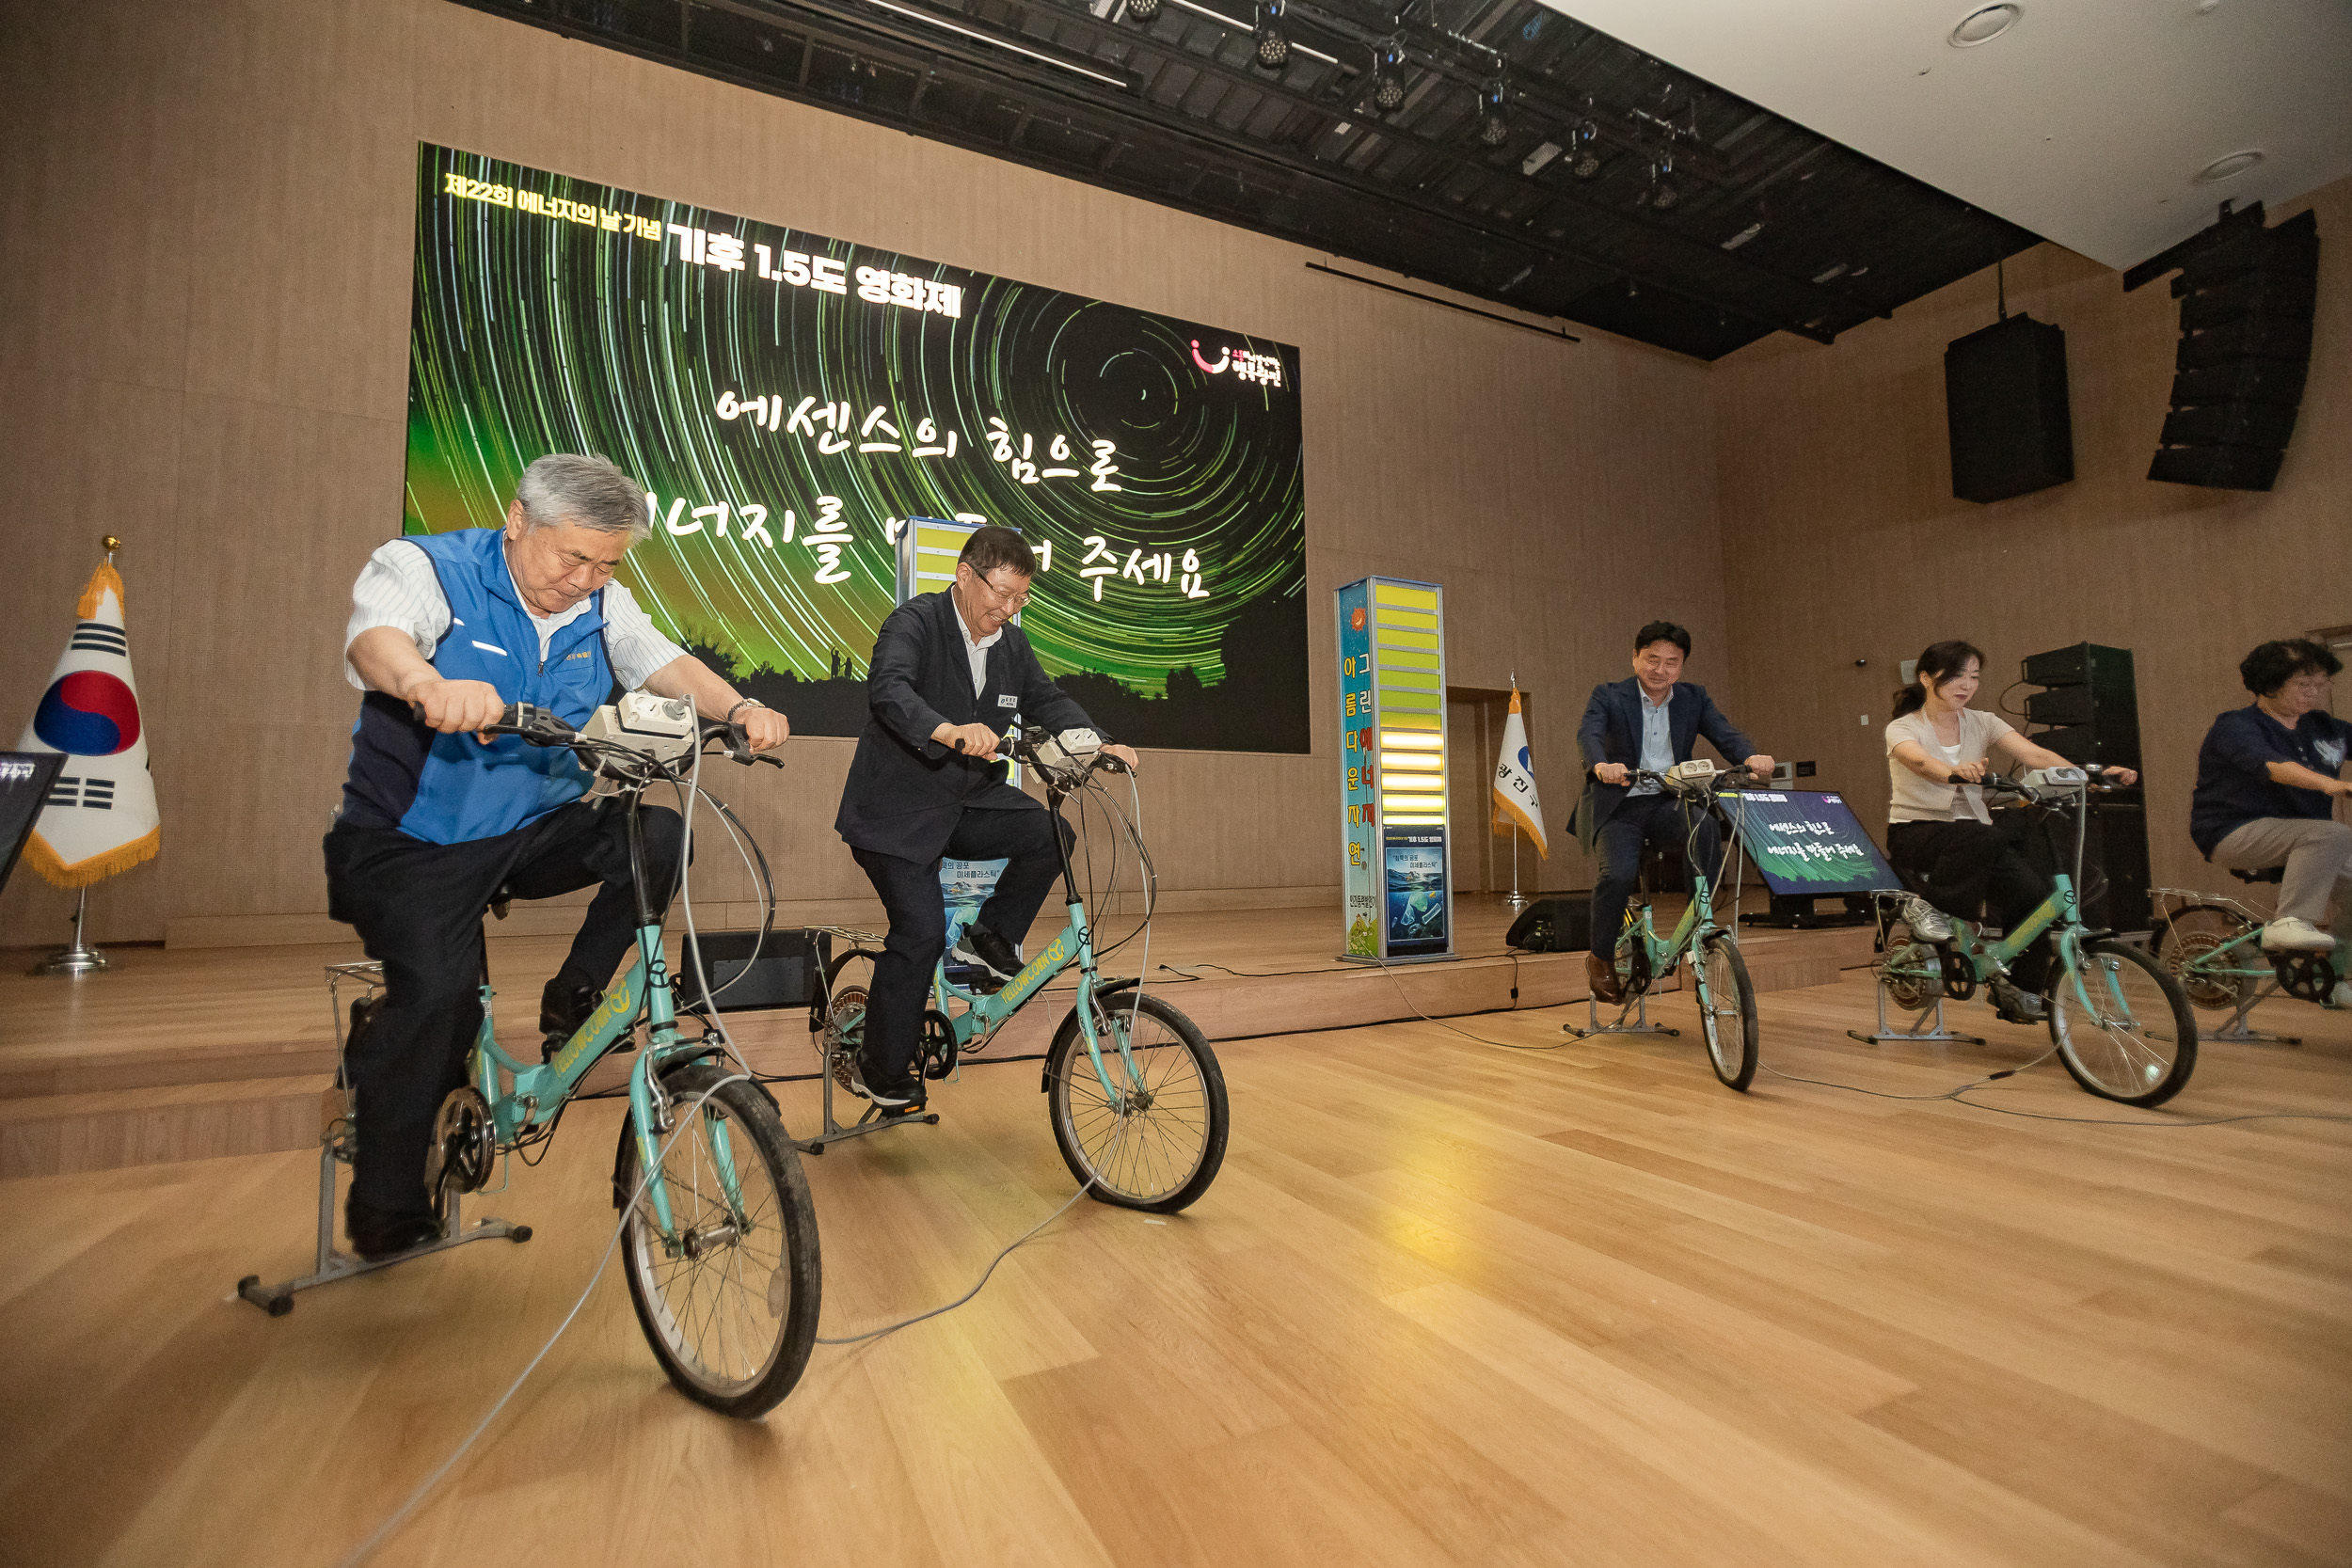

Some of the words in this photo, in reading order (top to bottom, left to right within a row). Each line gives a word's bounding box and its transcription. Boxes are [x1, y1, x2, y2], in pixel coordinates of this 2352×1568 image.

[444, 172, 513, 209] 제22회
[516, 190, 597, 228] 에너지의
[599, 208, 623, 232] 날
[623, 214, 661, 242] 기념
[666, 222, 745, 272] 기후
[754, 244, 847, 295] 1.5도
[855, 265, 961, 319] 영화제
[716, 390, 958, 458] 에센스의
[986, 416, 1122, 492] 힘으로
[645, 491, 853, 584] 너지를
[1078, 534, 1211, 603] 주세요
[1000, 952, 1051, 1005] YELLOWCORN
